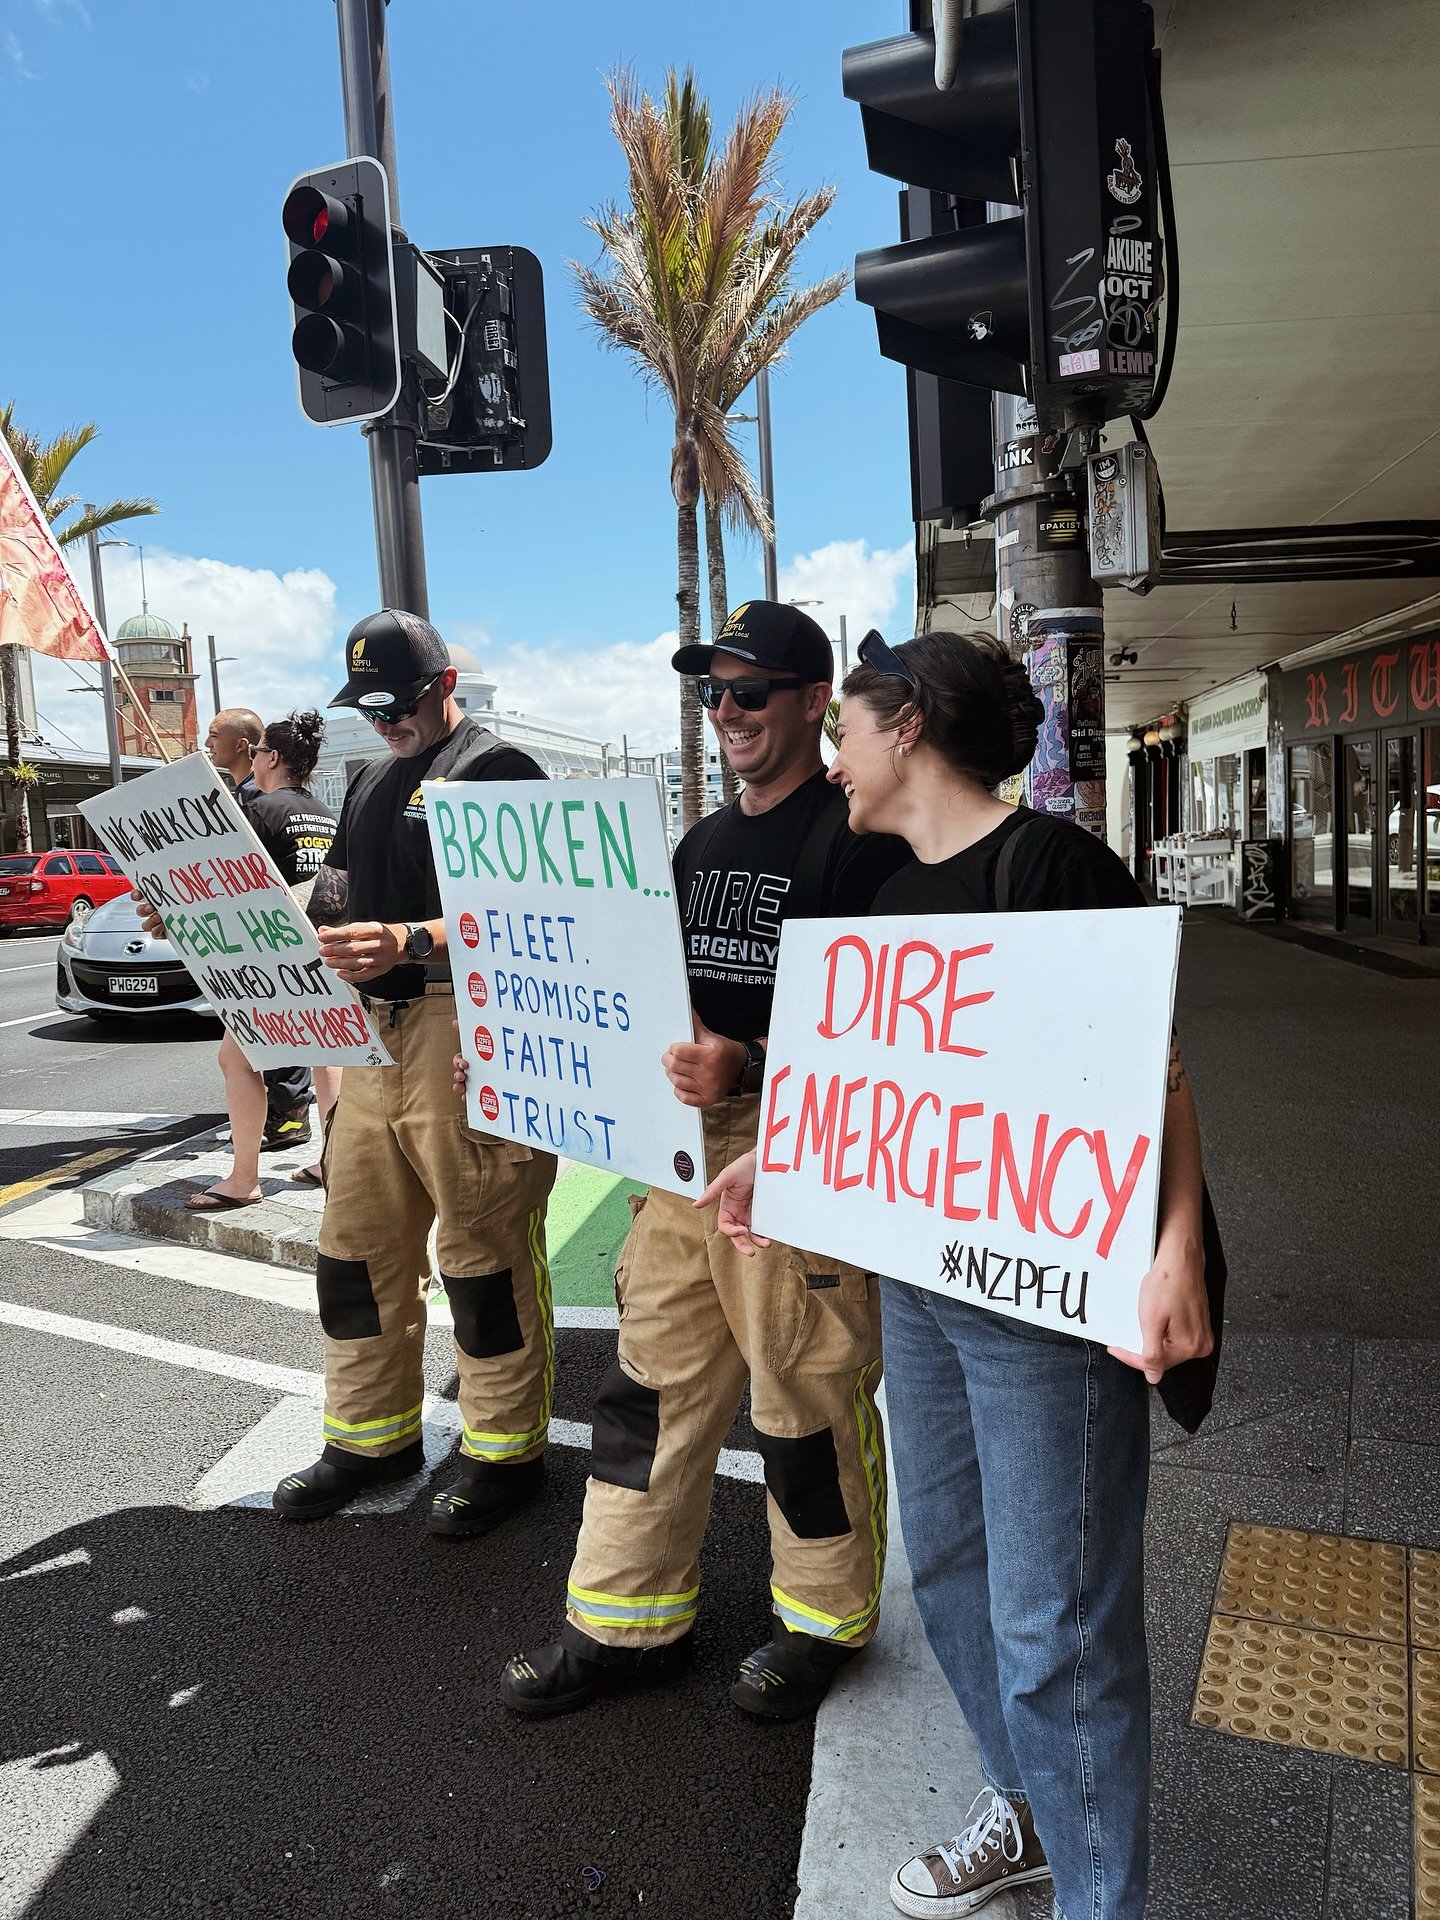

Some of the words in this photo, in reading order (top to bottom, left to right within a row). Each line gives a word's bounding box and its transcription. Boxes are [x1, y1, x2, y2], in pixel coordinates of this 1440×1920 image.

[1107, 237, 1152, 273] AKURE
[1107, 276, 1152, 299] OCT
[1108, 351, 1154, 374] LEMP
[998, 447, 1033, 472] LINK
[1071, 728, 1086, 738] Sid
[101, 815, 145, 861] WE
[128, 804, 190, 853] WALK
[181, 787, 238, 842] OUT
[289, 814, 301, 823] NZ
[135, 871, 180, 909] FOR
[168, 861, 225, 905] ONE
[164, 912, 244, 959] FENZ
[237, 907, 304, 954] HAS
[687, 934, 779, 966] ERGENCY
[110, 978, 156, 991] PWG294
[202, 964, 276, 1001] WALKED
[278, 958, 333, 997] OUT
[703, 968, 727, 981] YOUR
[727, 972, 743, 983] FIRE
[816, 934, 995, 1058] DIRE
[494, 969, 631, 1032] PROMISES
[221, 1007, 268, 1046] FOR
[252, 1006, 312, 1047] THREE
[502, 1026, 592, 1088] FAITH
[502, 1091, 616, 1161] TRUST
[761, 1064, 1151, 1260] EMERGENCY
[939, 1239, 1089, 1324] #NZPFU
